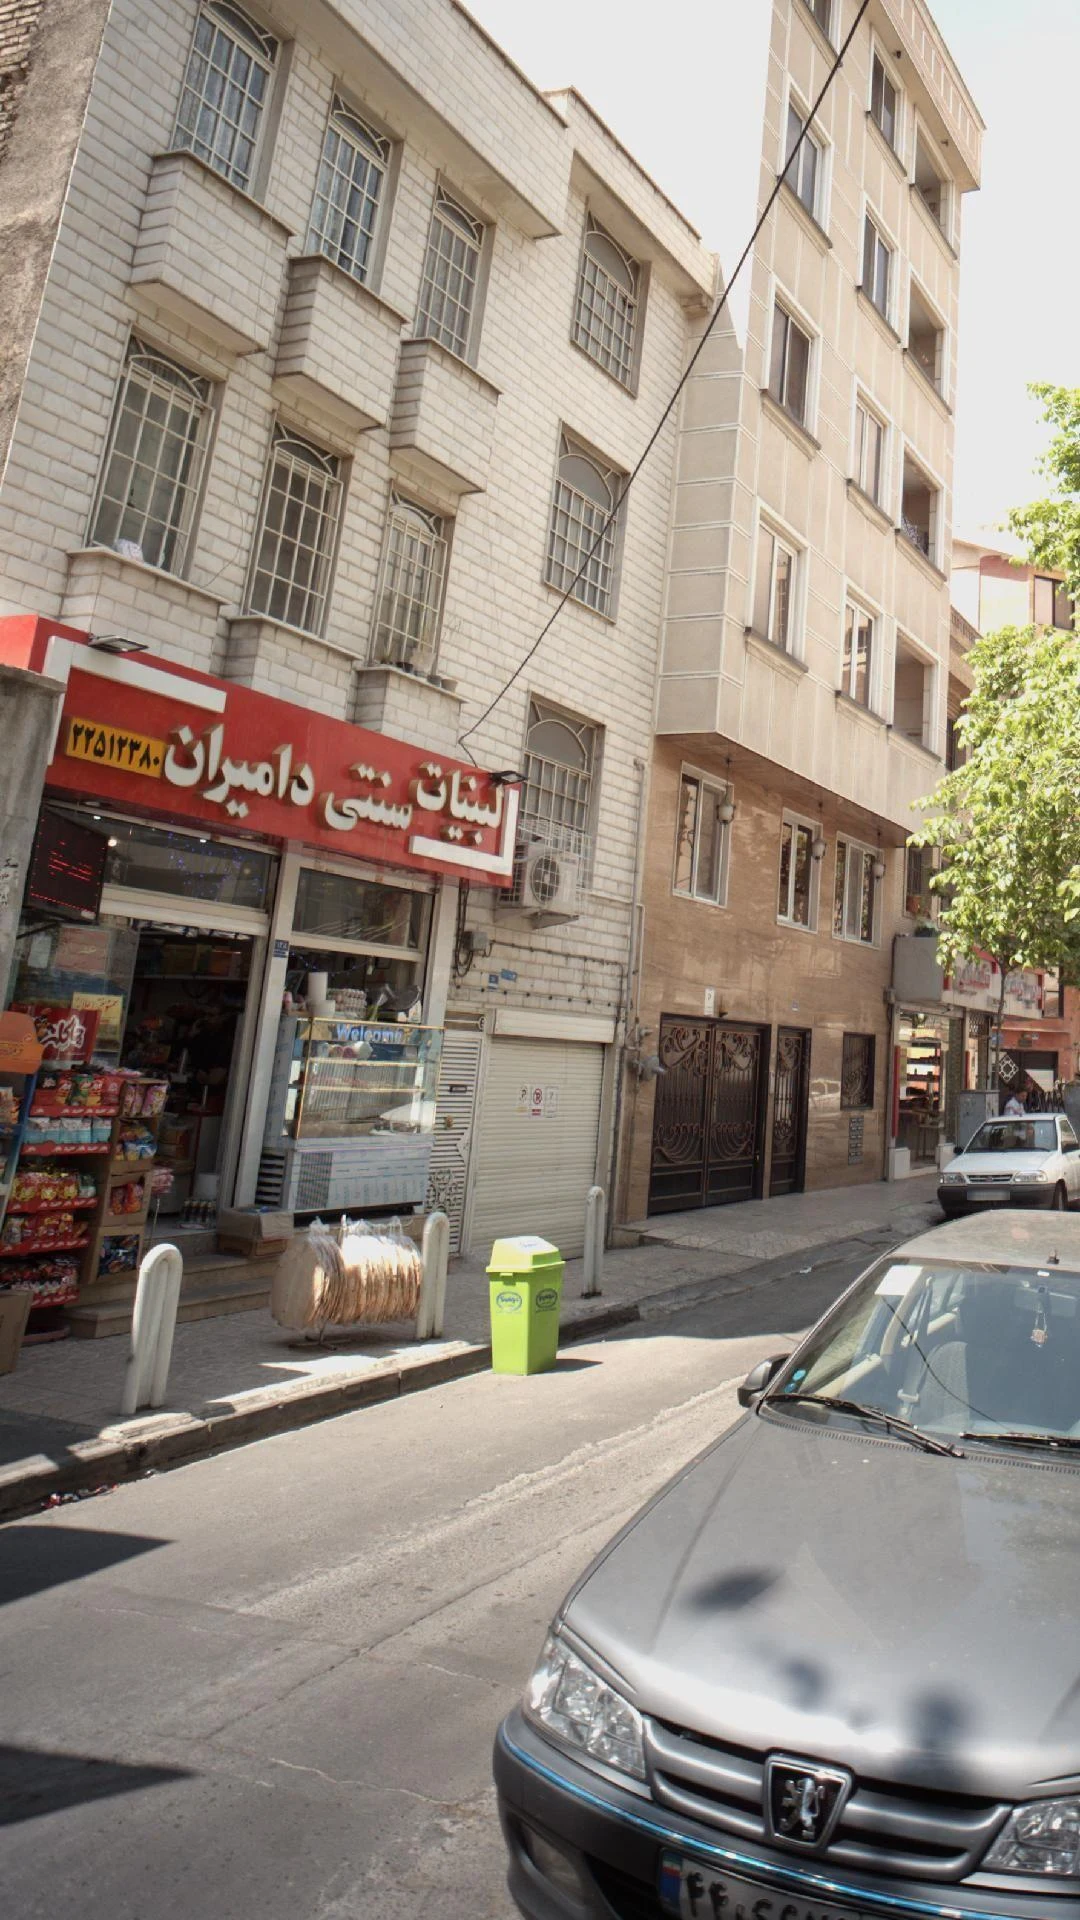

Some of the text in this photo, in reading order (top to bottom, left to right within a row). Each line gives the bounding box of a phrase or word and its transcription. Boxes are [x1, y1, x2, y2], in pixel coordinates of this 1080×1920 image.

[164, 723, 504, 845] لبنیات سنتی دامیران
[336, 1023, 404, 1044] Welcome
